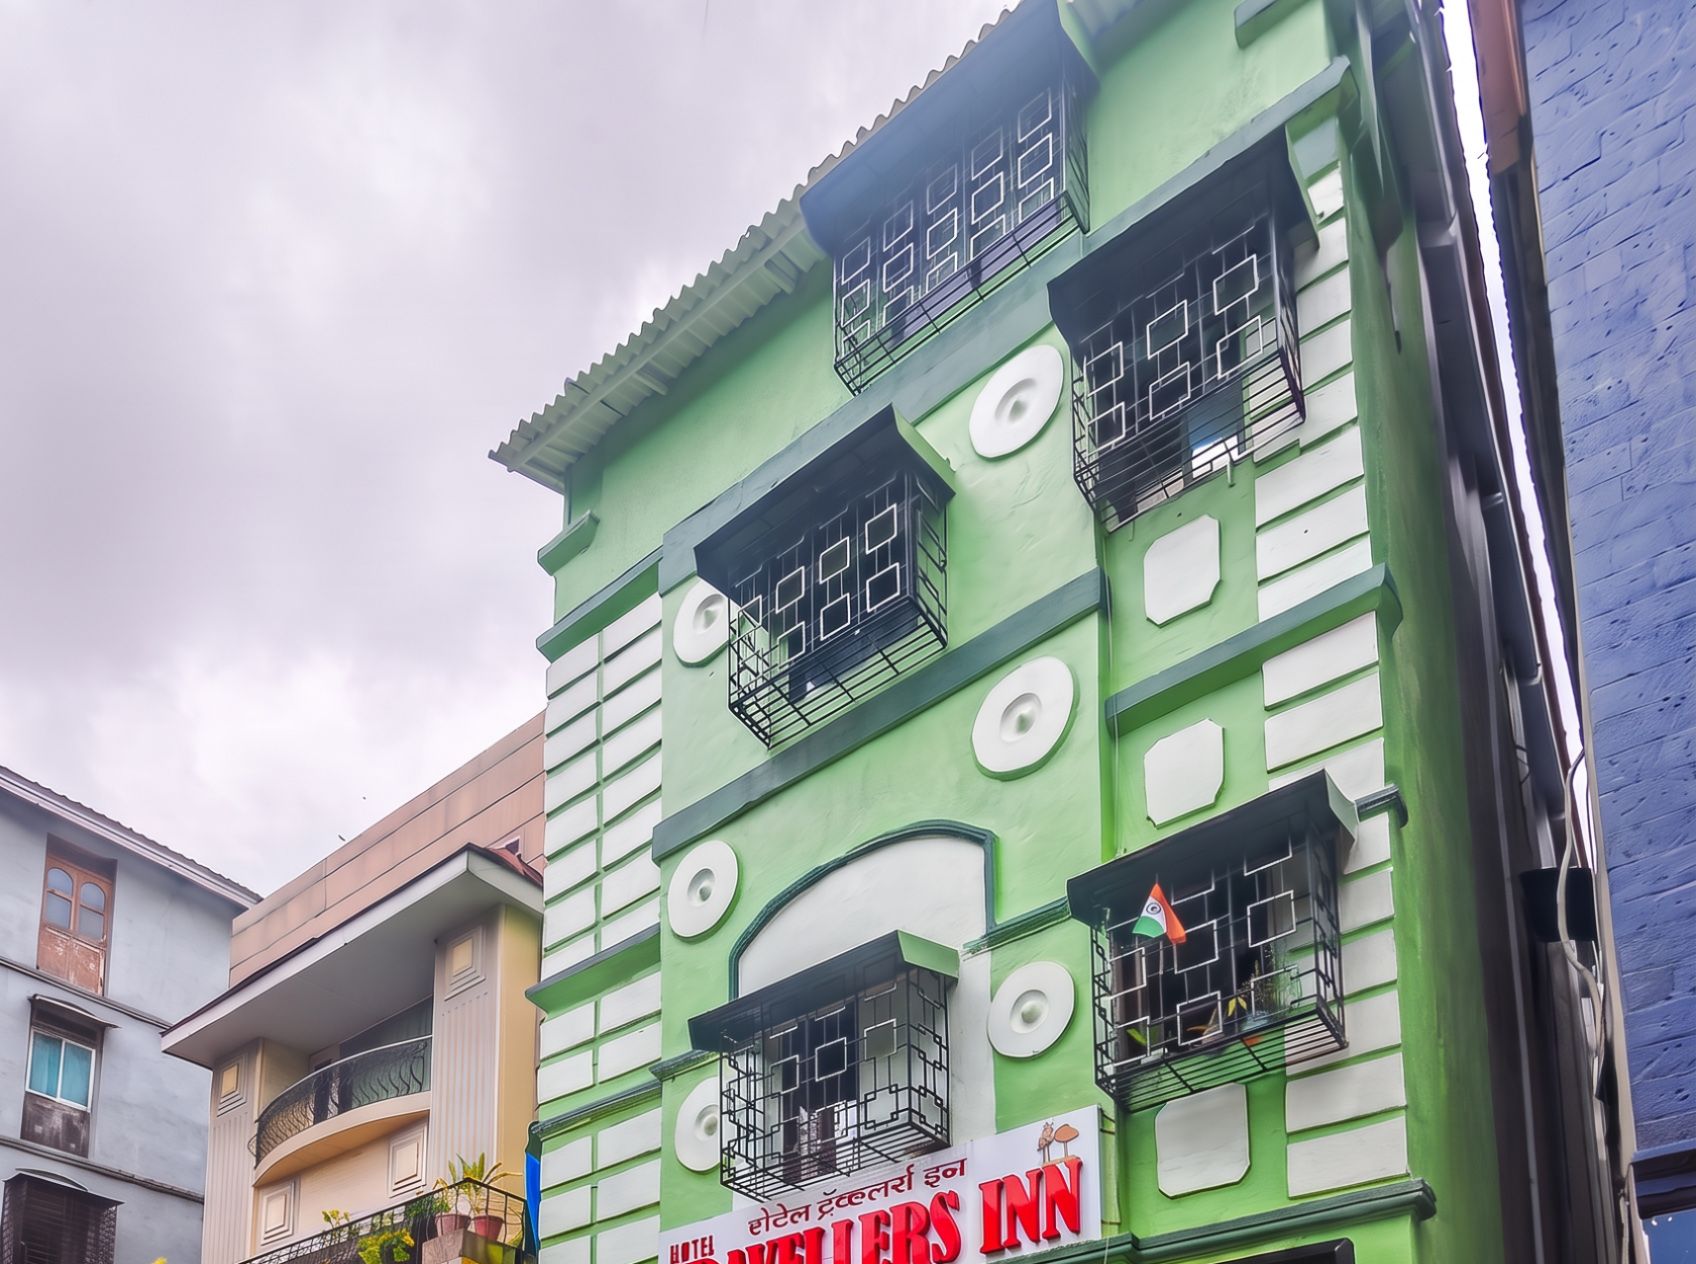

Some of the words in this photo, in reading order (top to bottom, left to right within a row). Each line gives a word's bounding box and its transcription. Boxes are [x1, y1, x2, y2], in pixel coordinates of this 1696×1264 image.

[748, 1203, 812, 1236] होटेल
[923, 1158, 967, 1188] इन
[978, 1156, 1084, 1256] INN
